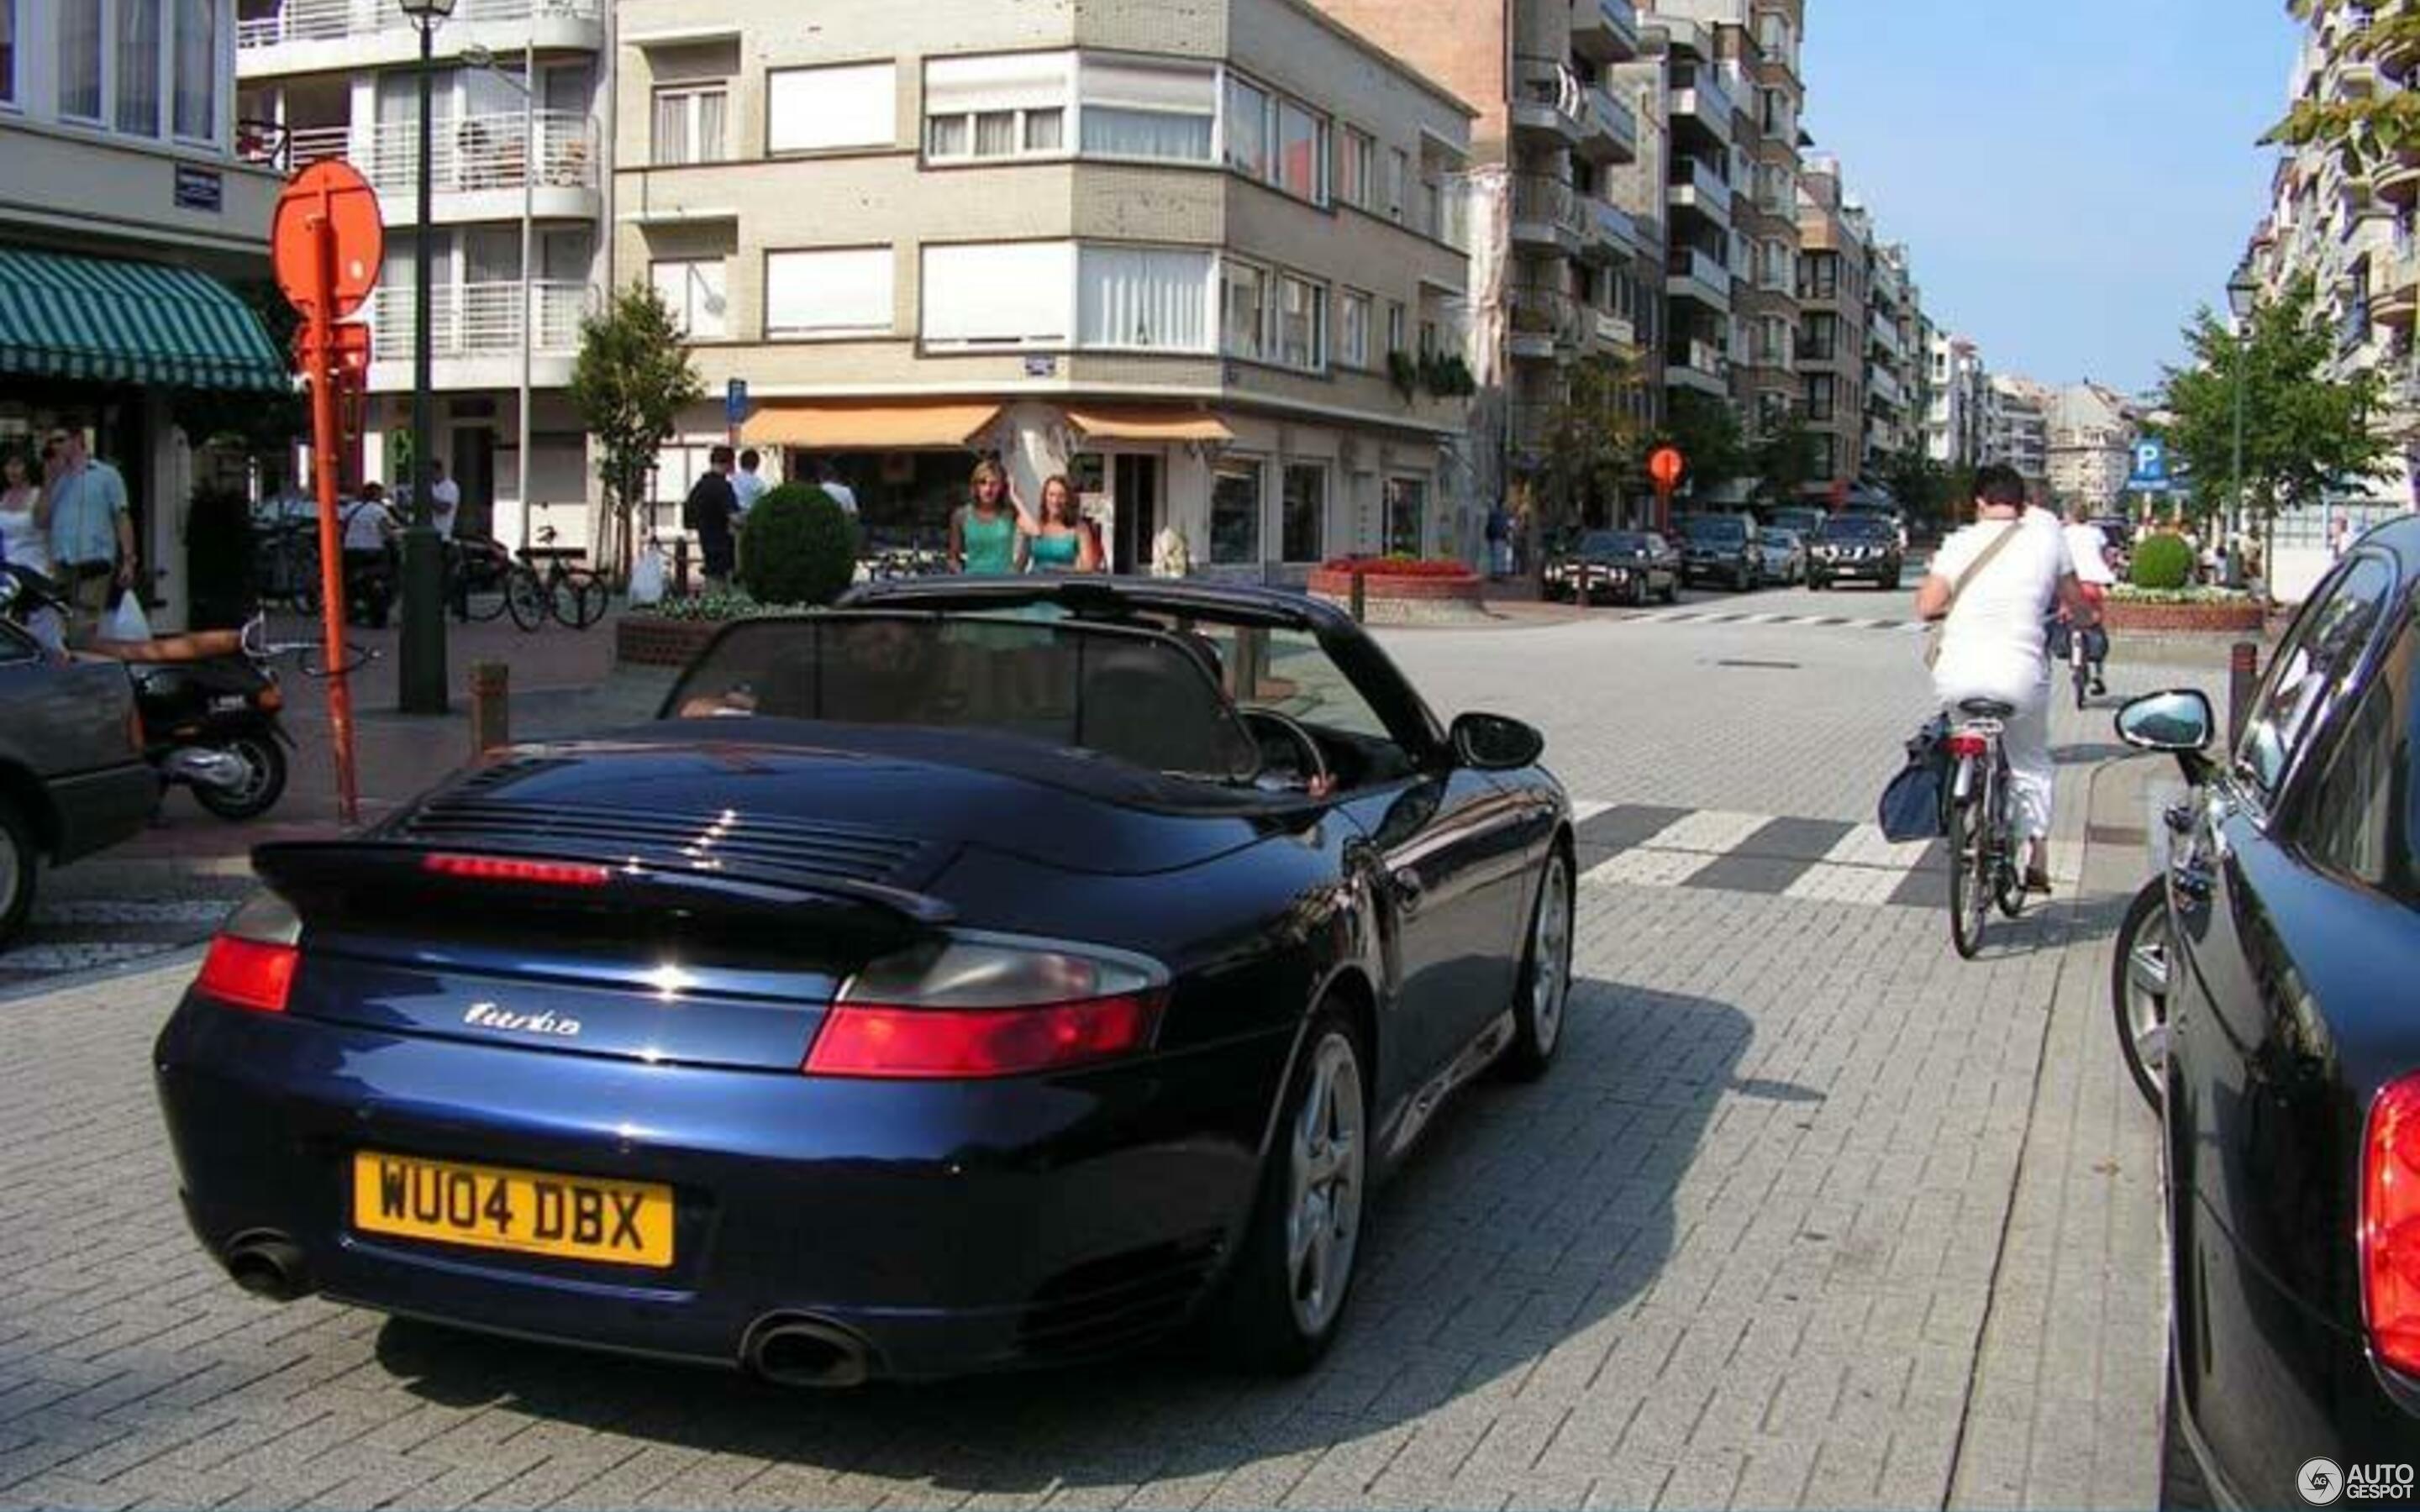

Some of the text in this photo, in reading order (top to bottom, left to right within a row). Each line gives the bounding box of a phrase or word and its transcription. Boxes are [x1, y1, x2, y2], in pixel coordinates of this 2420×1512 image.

[2138, 444, 2158, 472] P
[381, 1158, 643, 1251] WU04 DBX
